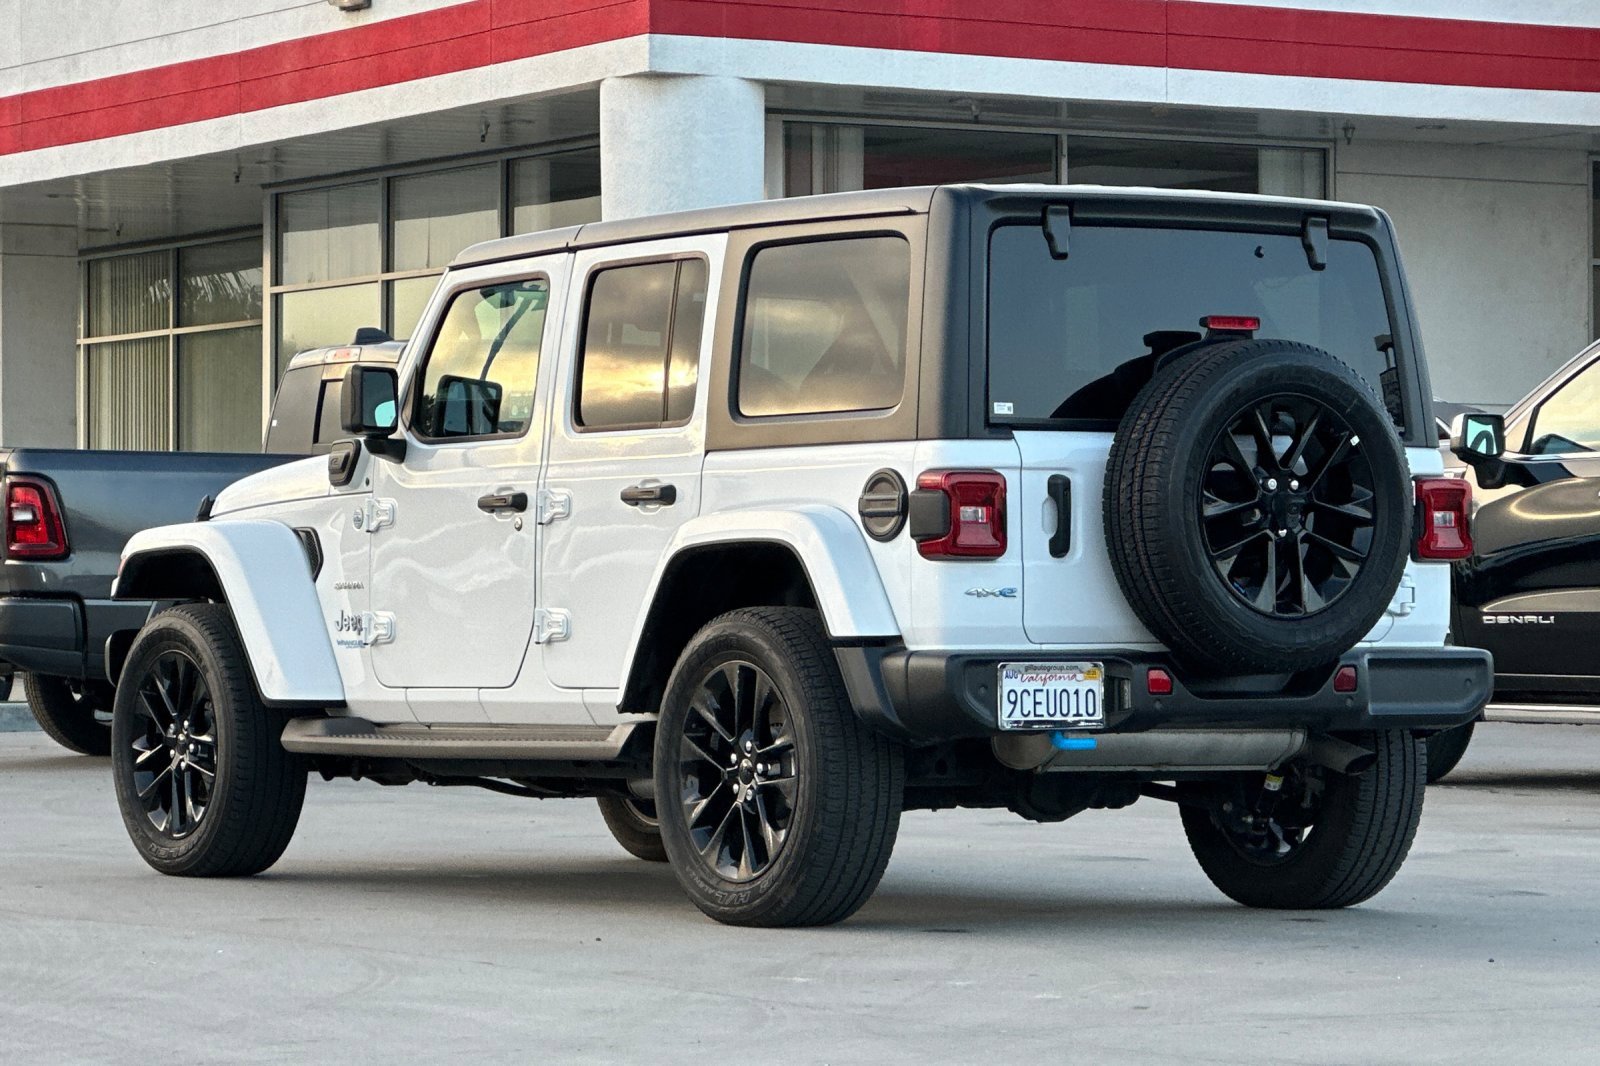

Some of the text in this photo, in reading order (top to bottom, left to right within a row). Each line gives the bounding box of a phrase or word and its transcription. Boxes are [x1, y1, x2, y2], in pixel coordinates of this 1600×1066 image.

[335, 610, 363, 635] Jeep
[1482, 615, 1555, 624] DENALI
[1005, 670, 1019, 679] AUG
[1020, 672, 1082, 686] California
[1007, 688, 1096, 718] 9CEU010
